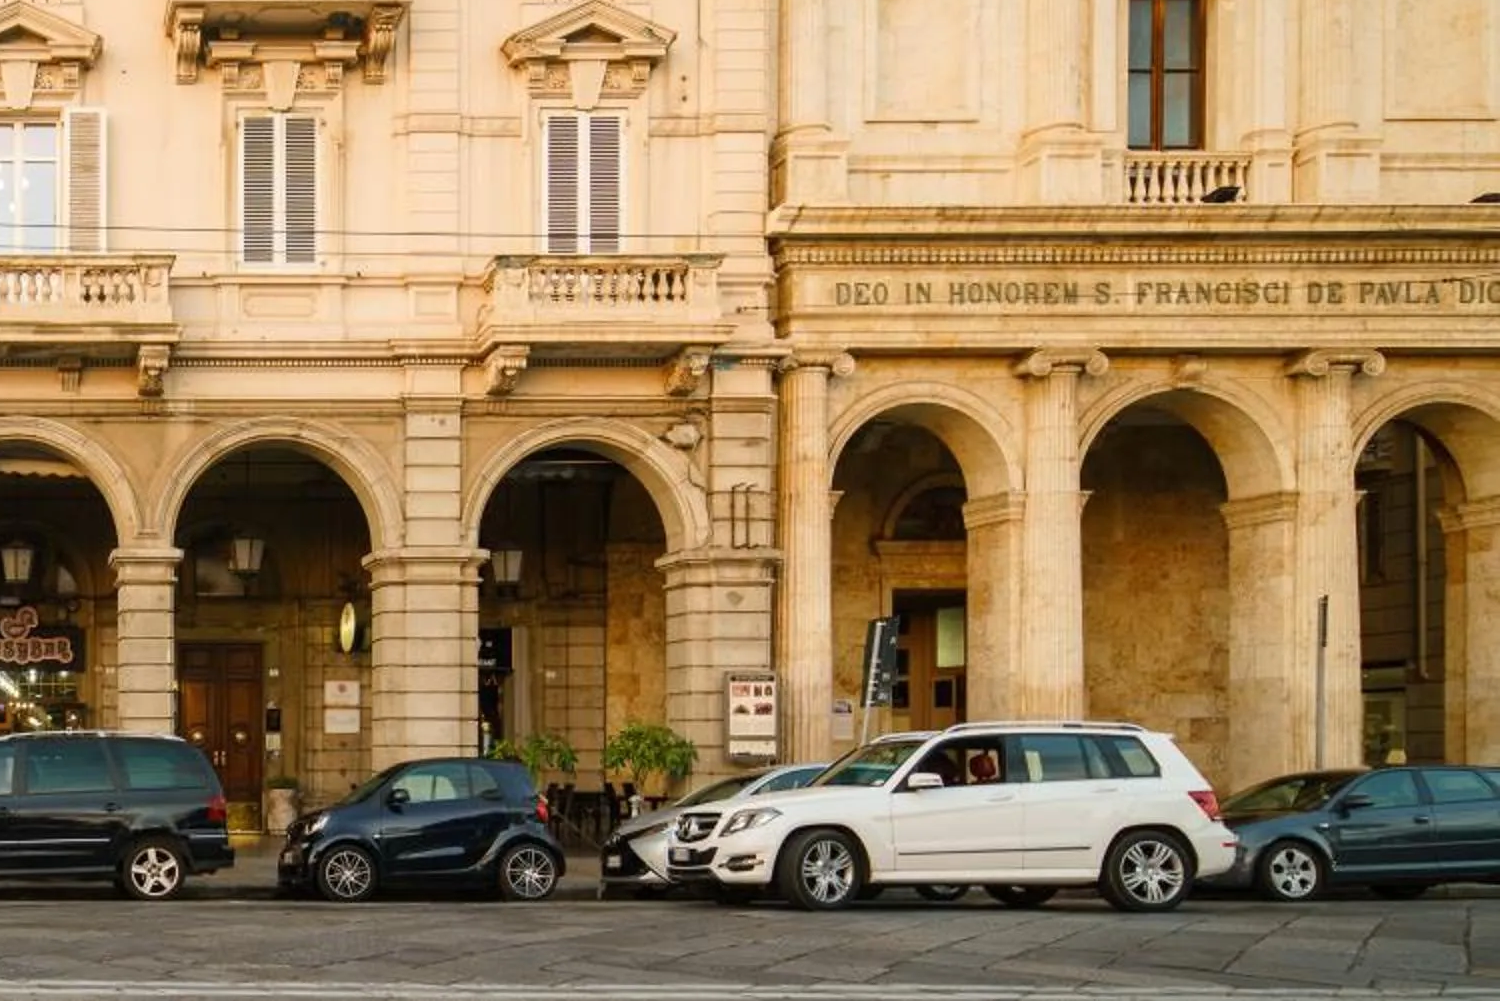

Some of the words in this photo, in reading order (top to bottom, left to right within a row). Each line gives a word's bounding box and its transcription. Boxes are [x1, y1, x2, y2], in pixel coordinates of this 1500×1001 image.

[834, 282, 889, 305] DEO
[904, 282, 932, 305] IN
[948, 282, 1079, 305] HONOREM
[1093, 282, 1121, 305] S.
[1137, 281, 1290, 305] FRANCISCI
[1306, 281, 1344, 305] DE
[1359, 281, 1440, 305] PAVLA
